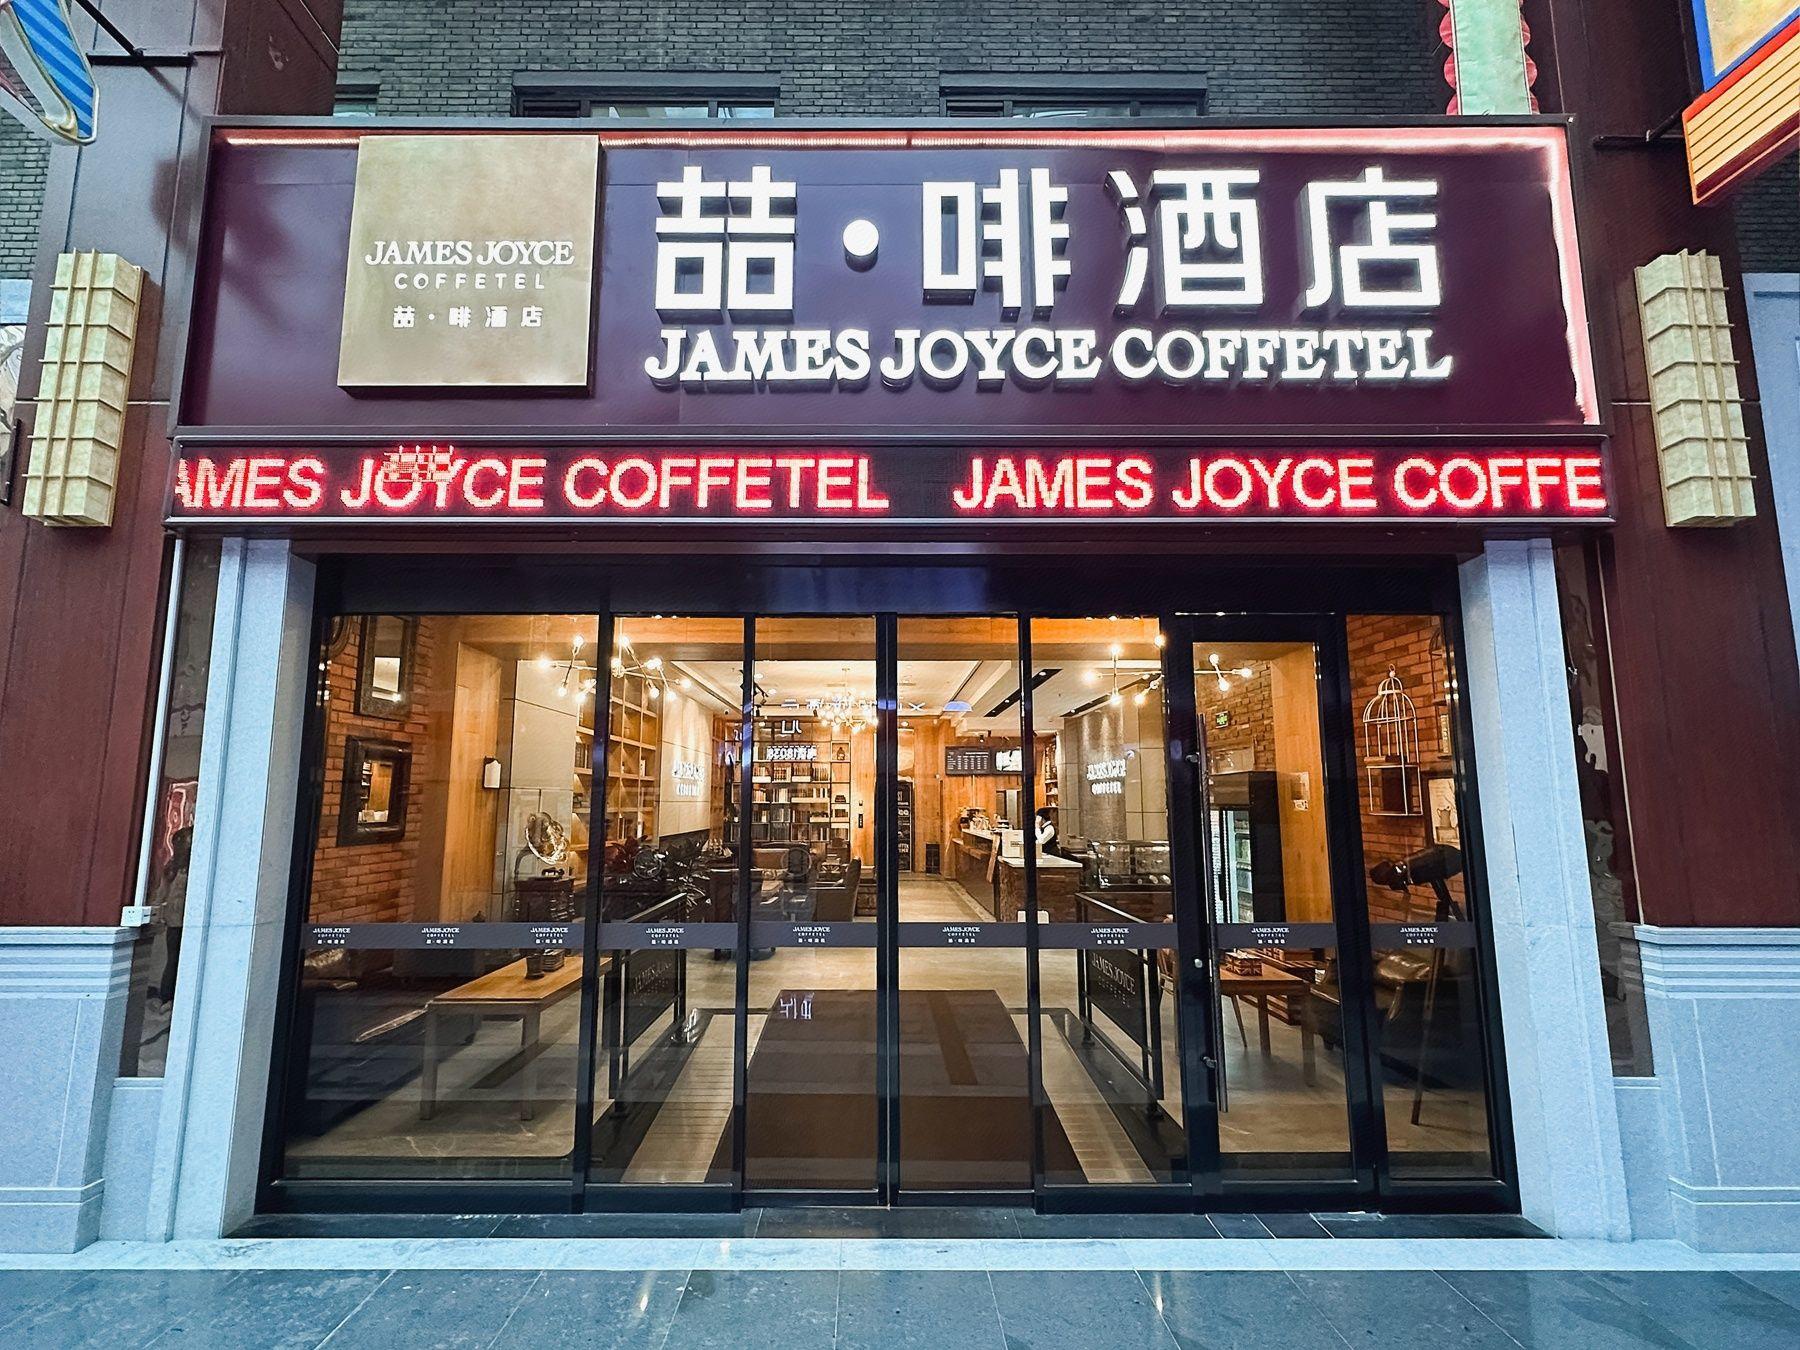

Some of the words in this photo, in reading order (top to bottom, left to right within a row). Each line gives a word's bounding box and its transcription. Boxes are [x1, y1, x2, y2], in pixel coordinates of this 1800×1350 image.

[365, 240, 473, 266] JAMES
[476, 240, 575, 266] JOYCE
[394, 273, 545, 290] COFFETEL
[644, 328, 871, 381] JAMES
[879, 327, 1102, 382] JOYCE
[1111, 328, 1453, 380] COFFETEL
[563, 458, 890, 508] COFFETEL
[953, 457, 1154, 508] JAMES
[1172, 457, 1378, 508] JOYCE
[1394, 457, 1607, 508] COFFE
